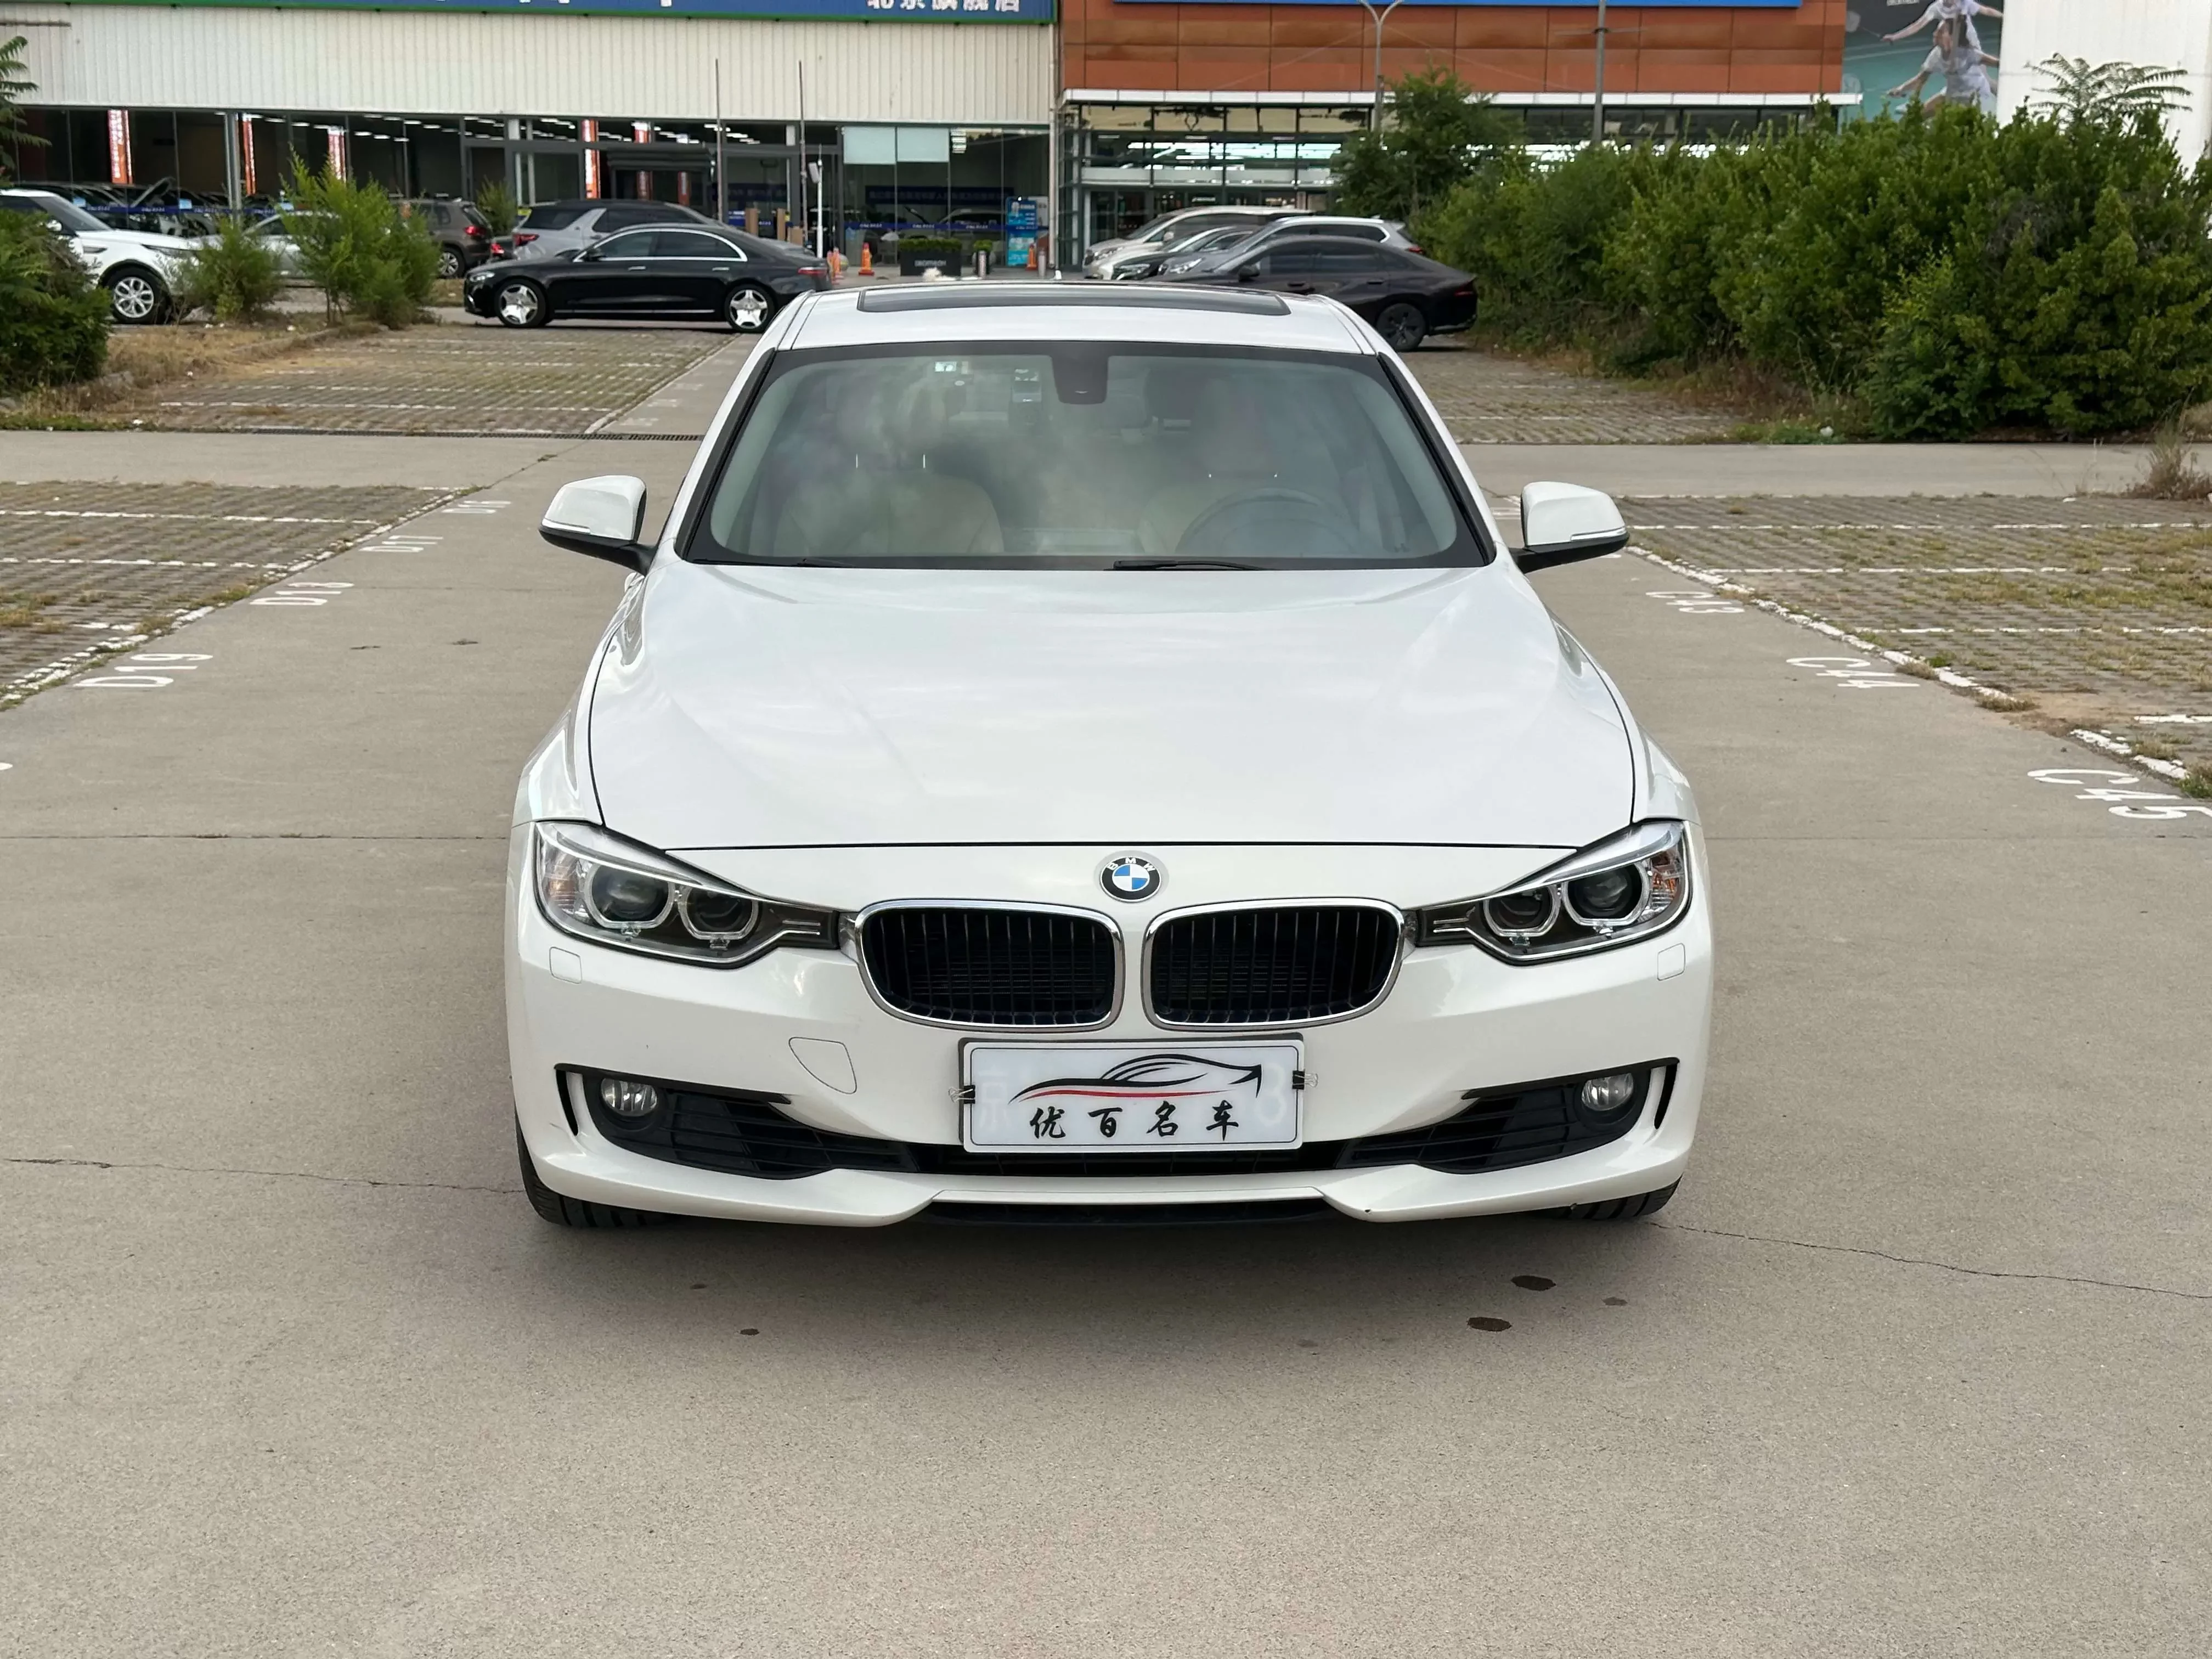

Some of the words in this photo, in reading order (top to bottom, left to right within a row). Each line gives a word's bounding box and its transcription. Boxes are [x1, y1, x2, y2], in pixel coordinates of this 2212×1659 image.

[250, 582, 354, 605] D18
[1645, 591, 1745, 614] C43
[73, 653, 213, 687] D19
[1786, 657, 1920, 689] C44
[2027, 769, 2212, 819] C45
[1105, 857, 1156, 872] BMW
[1029, 1099, 1239, 1141] 优百名车
